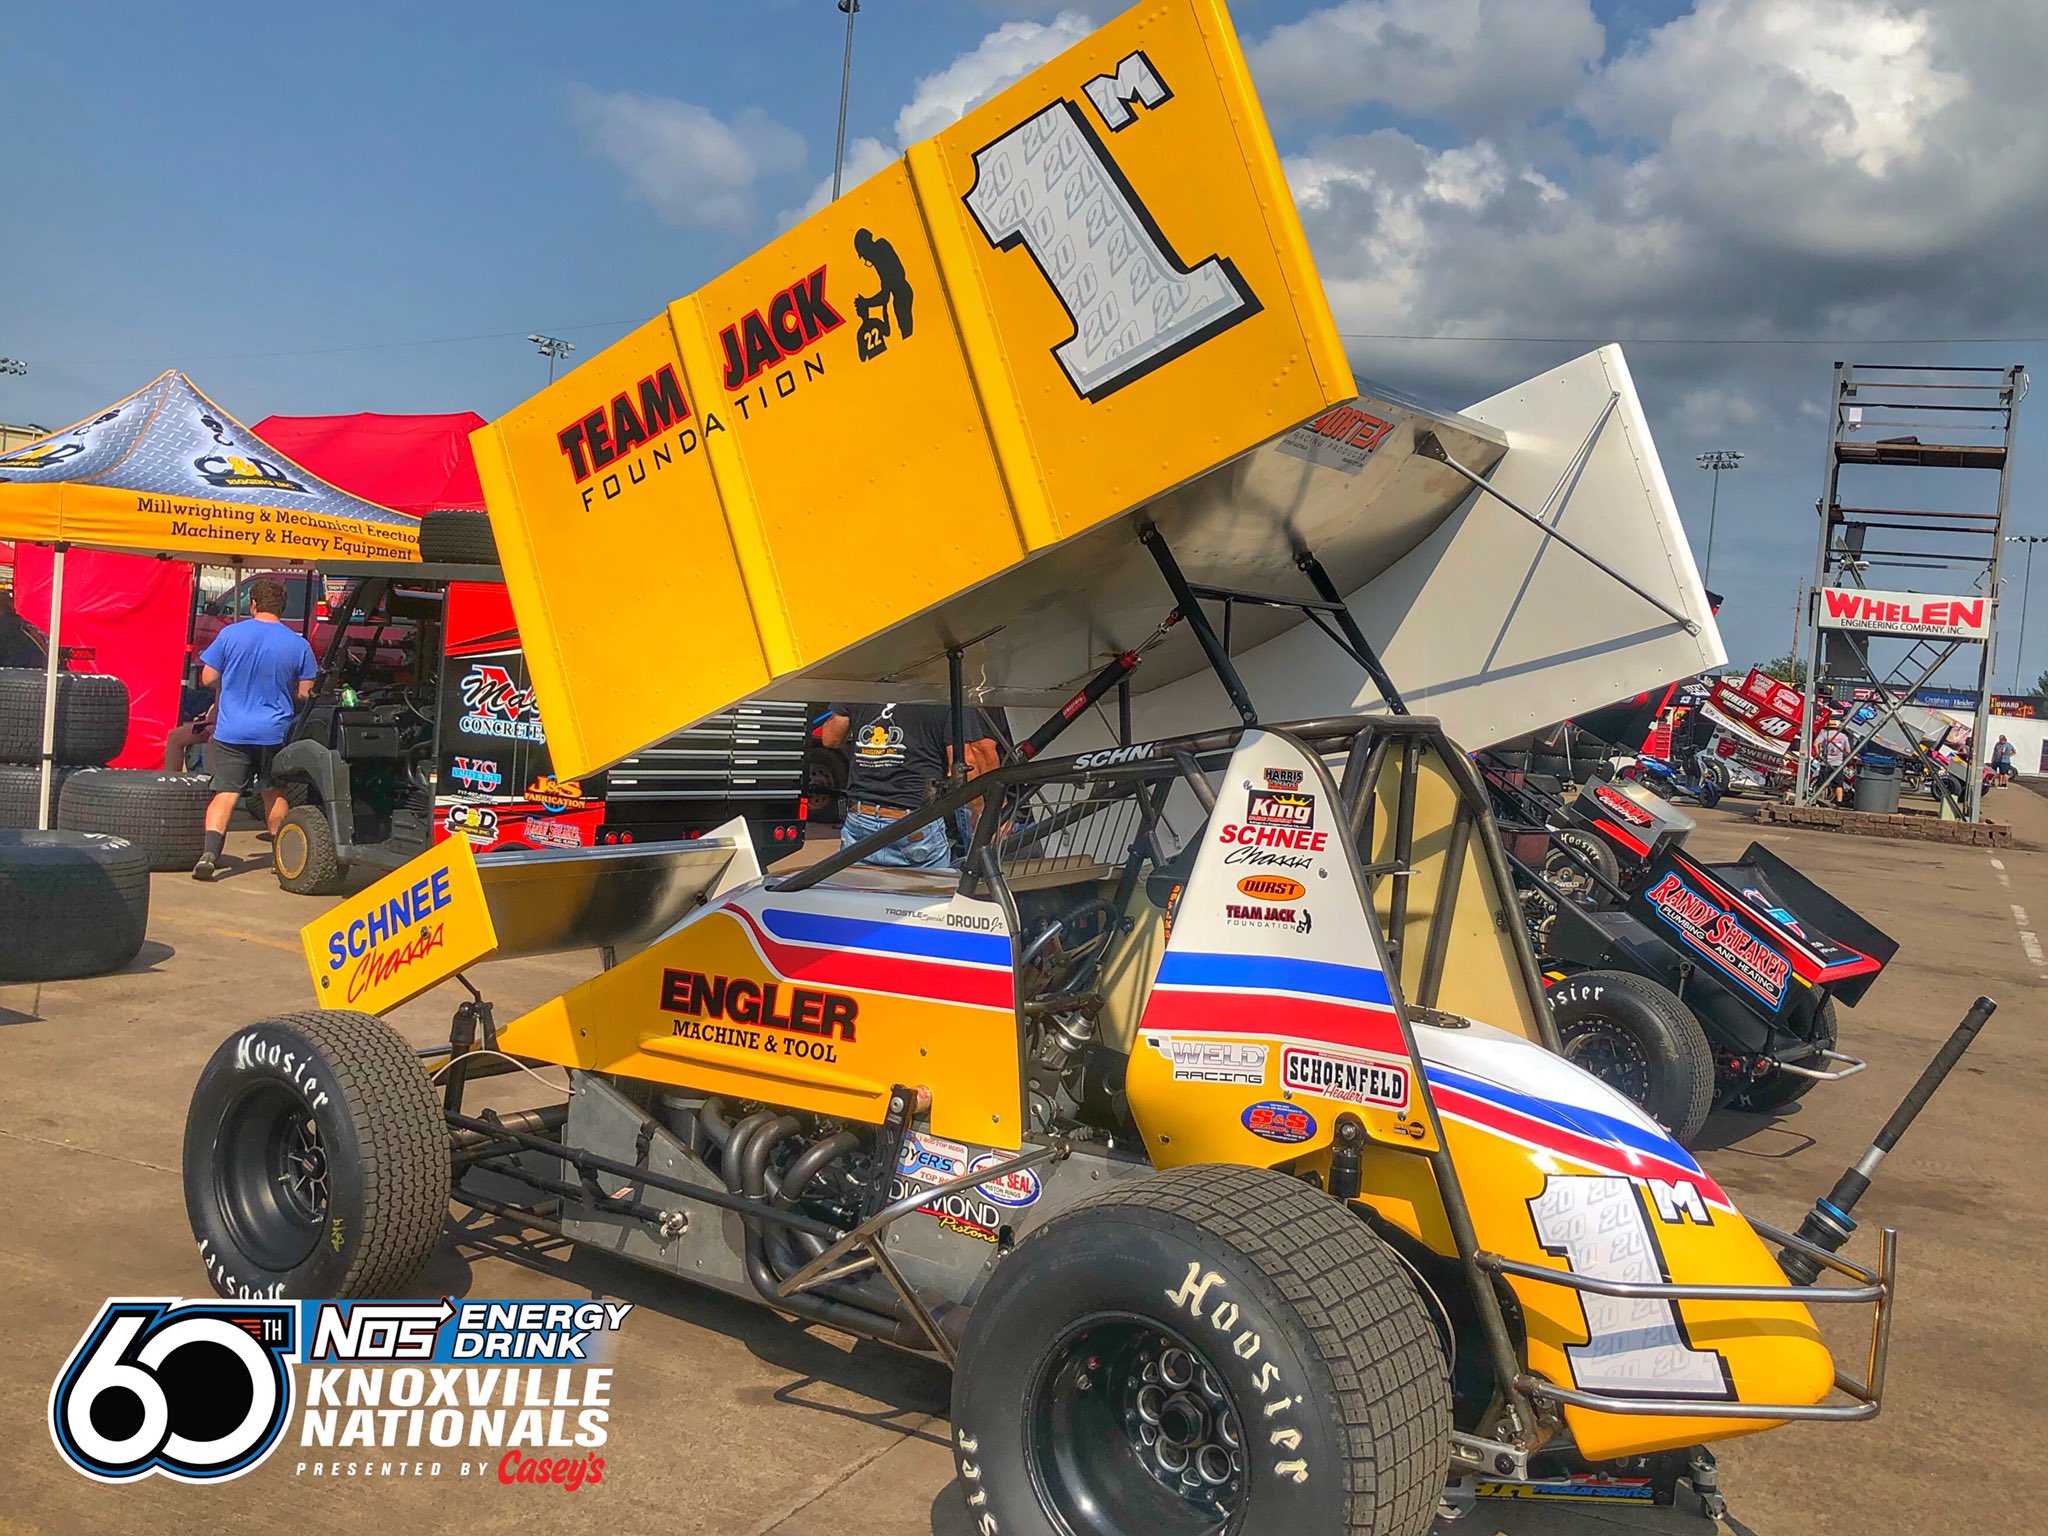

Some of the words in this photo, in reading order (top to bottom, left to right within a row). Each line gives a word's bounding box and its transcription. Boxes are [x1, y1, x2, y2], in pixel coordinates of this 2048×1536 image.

[556, 362, 692, 485] TEAM
[719, 264, 847, 392] JACK
[581, 352, 826, 513] FOUNDATION
[1327, 442, 1368, 460] PRODUCTS
[194, 455, 287, 480] C&D
[137, 497, 255, 524] Millwrighting
[260, 510, 271, 522] &
[276, 511, 363, 534] Mechanical
[171, 521, 259, 545] Machinery
[265, 529, 276, 543] &
[281, 530, 330, 551] Heavy
[333, 537, 412, 560] Equipment
[1825, 590, 1984, 628] WHELEN
[1841, 619, 1899, 630] ENGINEERING
[1900, 623, 1945, 635] COMPANY,
[1947, 627, 1965, 636] INC.
[1720, 688, 1760, 715] WEIKERT'S
[858, 725, 904, 746] C&D
[1758, 716, 1793, 737] 48
[1740, 746, 1790, 766] SWEENEY
[455, 757, 498, 793] VS
[1265, 769, 1303, 782] HARRIS
[524, 792, 586, 809] FABRICATION
[1250, 798, 1312, 824] King
[451, 807, 496, 829] C&D
[1219, 824, 1329, 852] SCHNEE
[1560, 833, 1600, 860] Hoosier
[1224, 846, 1314, 870] Chassis
[1243, 880, 1299, 895] DURST
[328, 865, 453, 970] SCHNEE
[885, 908, 922, 919] TROSTLE
[946, 914, 990, 930] DROUD
[990, 916, 1004, 932] Jr
[1226, 905, 1262, 920] TEAM
[1264, 907, 1297, 923] JACK
[1227, 919, 1296, 931] FOUNDATION
[1648, 874, 1720, 926] RANDY
[1706, 914, 1789, 987] SHEARER
[1662, 906, 1706, 940] PLUMBING
[1715, 946, 1736, 962] AND
[1738, 962, 1775, 992] HEATING
[348, 922, 445, 1005] Chassis
[660, 968, 859, 1043] ENGLER
[672, 1018, 762, 1050] MACHINE
[764, 1036, 779, 1054] &
[783, 1037, 837, 1063] TOOL
[1171, 1042, 1265, 1068] WELD
[234, 1032, 329, 1110] Hoosier
[1175, 1070, 1263, 1084] RACING
[1289, 1055, 1401, 1099] SCHOENFELD
[1323, 1084, 1364, 1104] Headers
[900, 1146, 954, 1171] DYER'S
[920, 1171, 938, 1181] TOP
[985, 1184, 1004, 1193] PISTON
[1007, 1172, 1032, 1194] SEAL
[939, 1215, 999, 1244] Pistons
[1164, 1262, 1309, 1484] Hoosier
